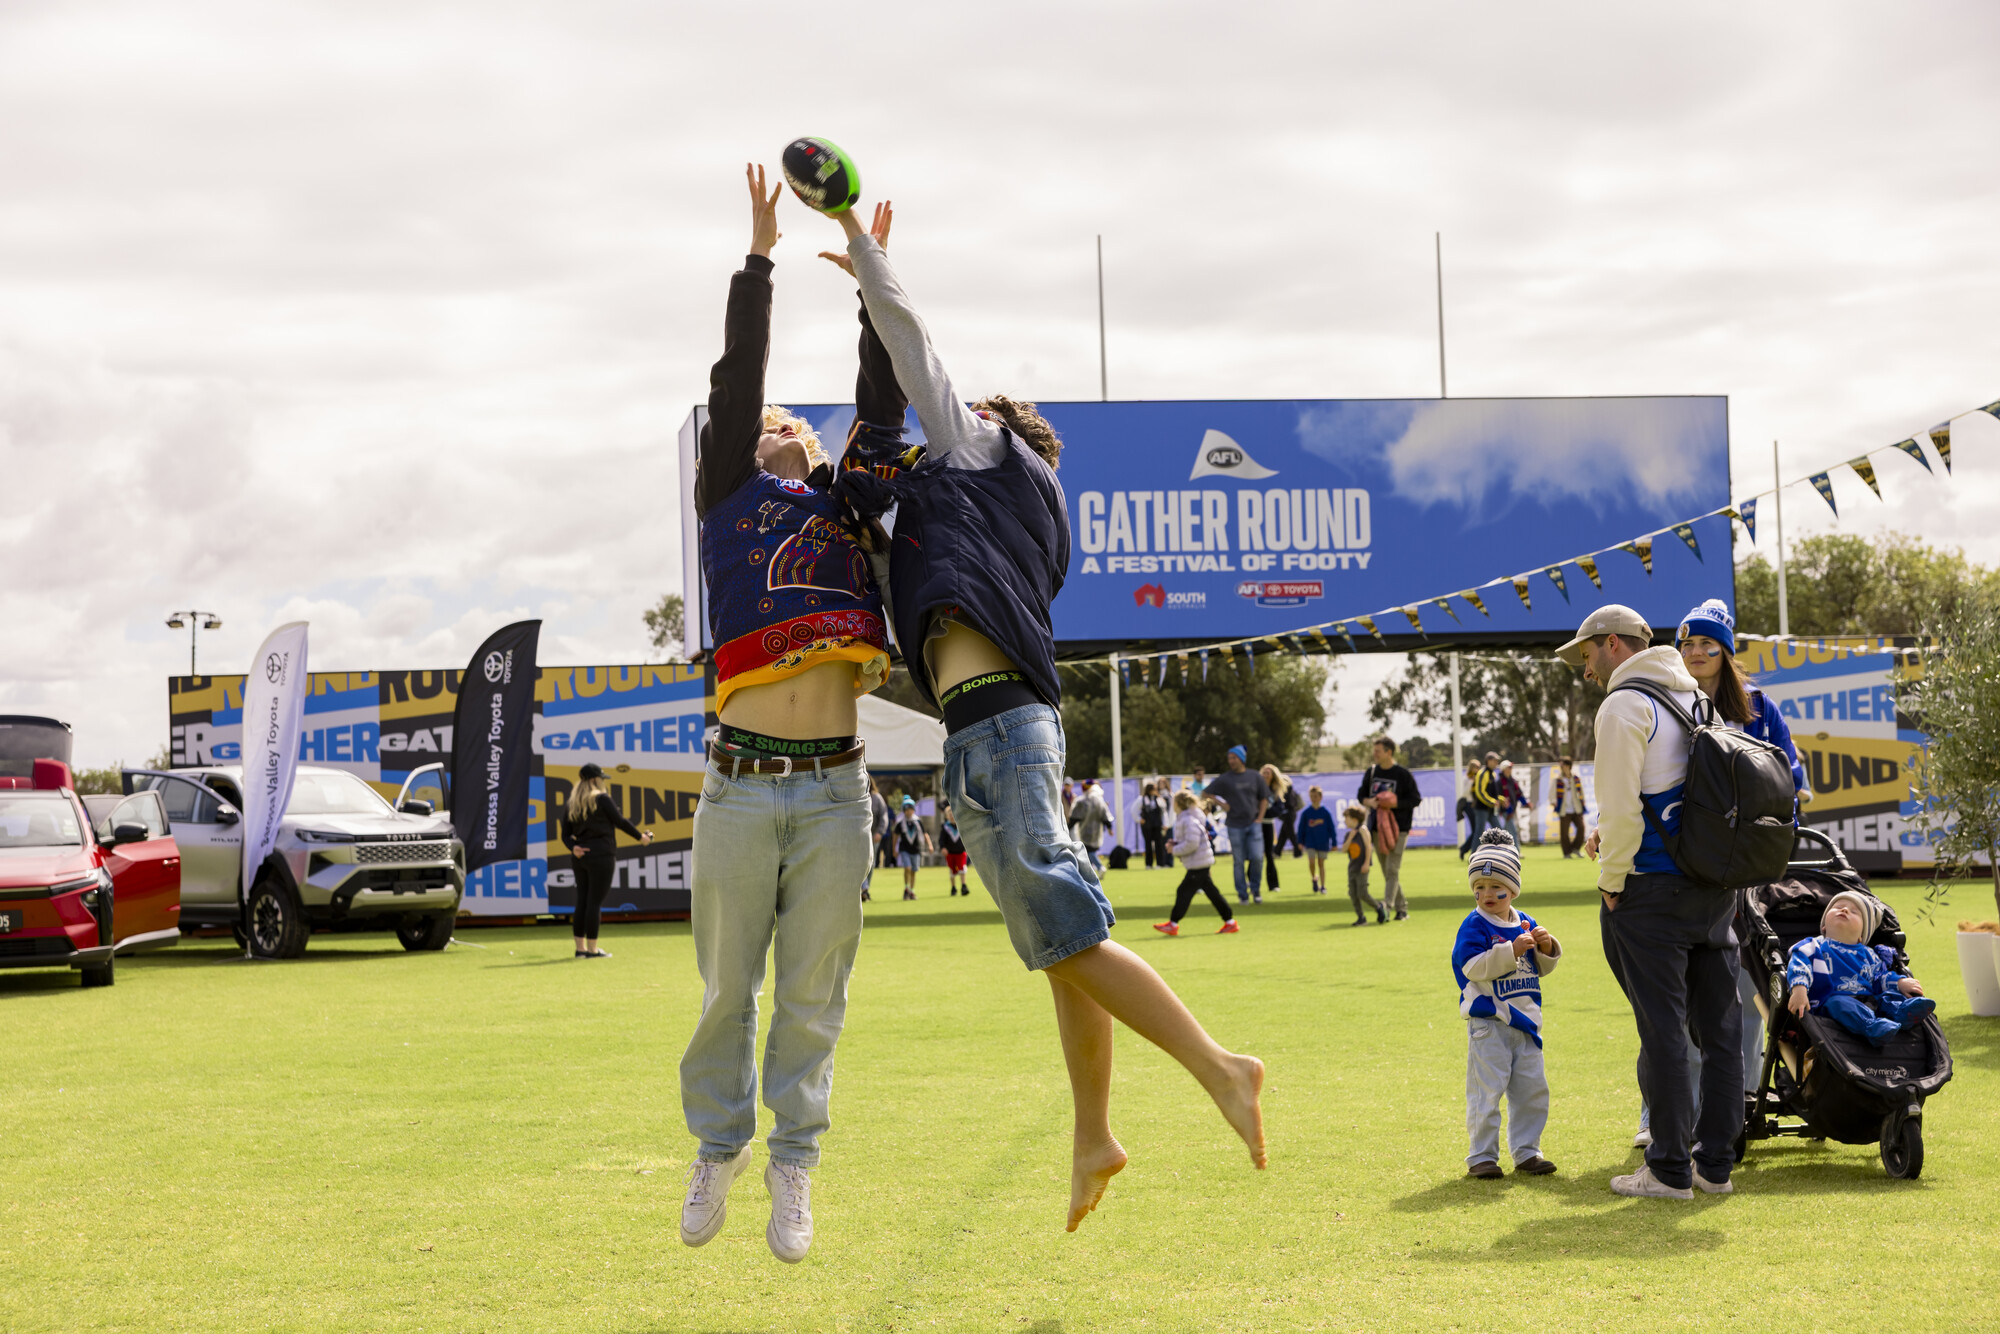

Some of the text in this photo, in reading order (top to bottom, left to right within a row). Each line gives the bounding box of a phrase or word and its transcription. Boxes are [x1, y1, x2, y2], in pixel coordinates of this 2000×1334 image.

[1209, 452, 1241, 465] AFL
[779, 480, 814, 494] AFL
[1079, 488, 1371, 554] GATHER ROUND
[1081, 552, 1372, 574] A FESTIVAL OF FOOTY
[1167, 592, 1206, 604] SOUTH
[1237, 584, 1263, 595] AFL
[1283, 585, 1320, 594] TOYOTA
[280, 651, 289, 686] TOYOTA
[503, 649, 513, 684] TOYOTA
[962, 673, 1009, 693] BONDS
[1779, 684, 1897, 722] ATHER
[266, 696, 279, 746] Toyota
[543, 713, 706, 754] GATHER
[754, 737, 816, 754] SWAG
[265, 751, 281, 795] Valley
[483, 693, 504, 850] Barossa Valley Toyota
[1803, 748, 1899, 794] UND
[545, 776, 701, 842] RUND
[386, 834, 422, 842] TOYOTA
[1499, 976, 1541, 995] KANGAROO
